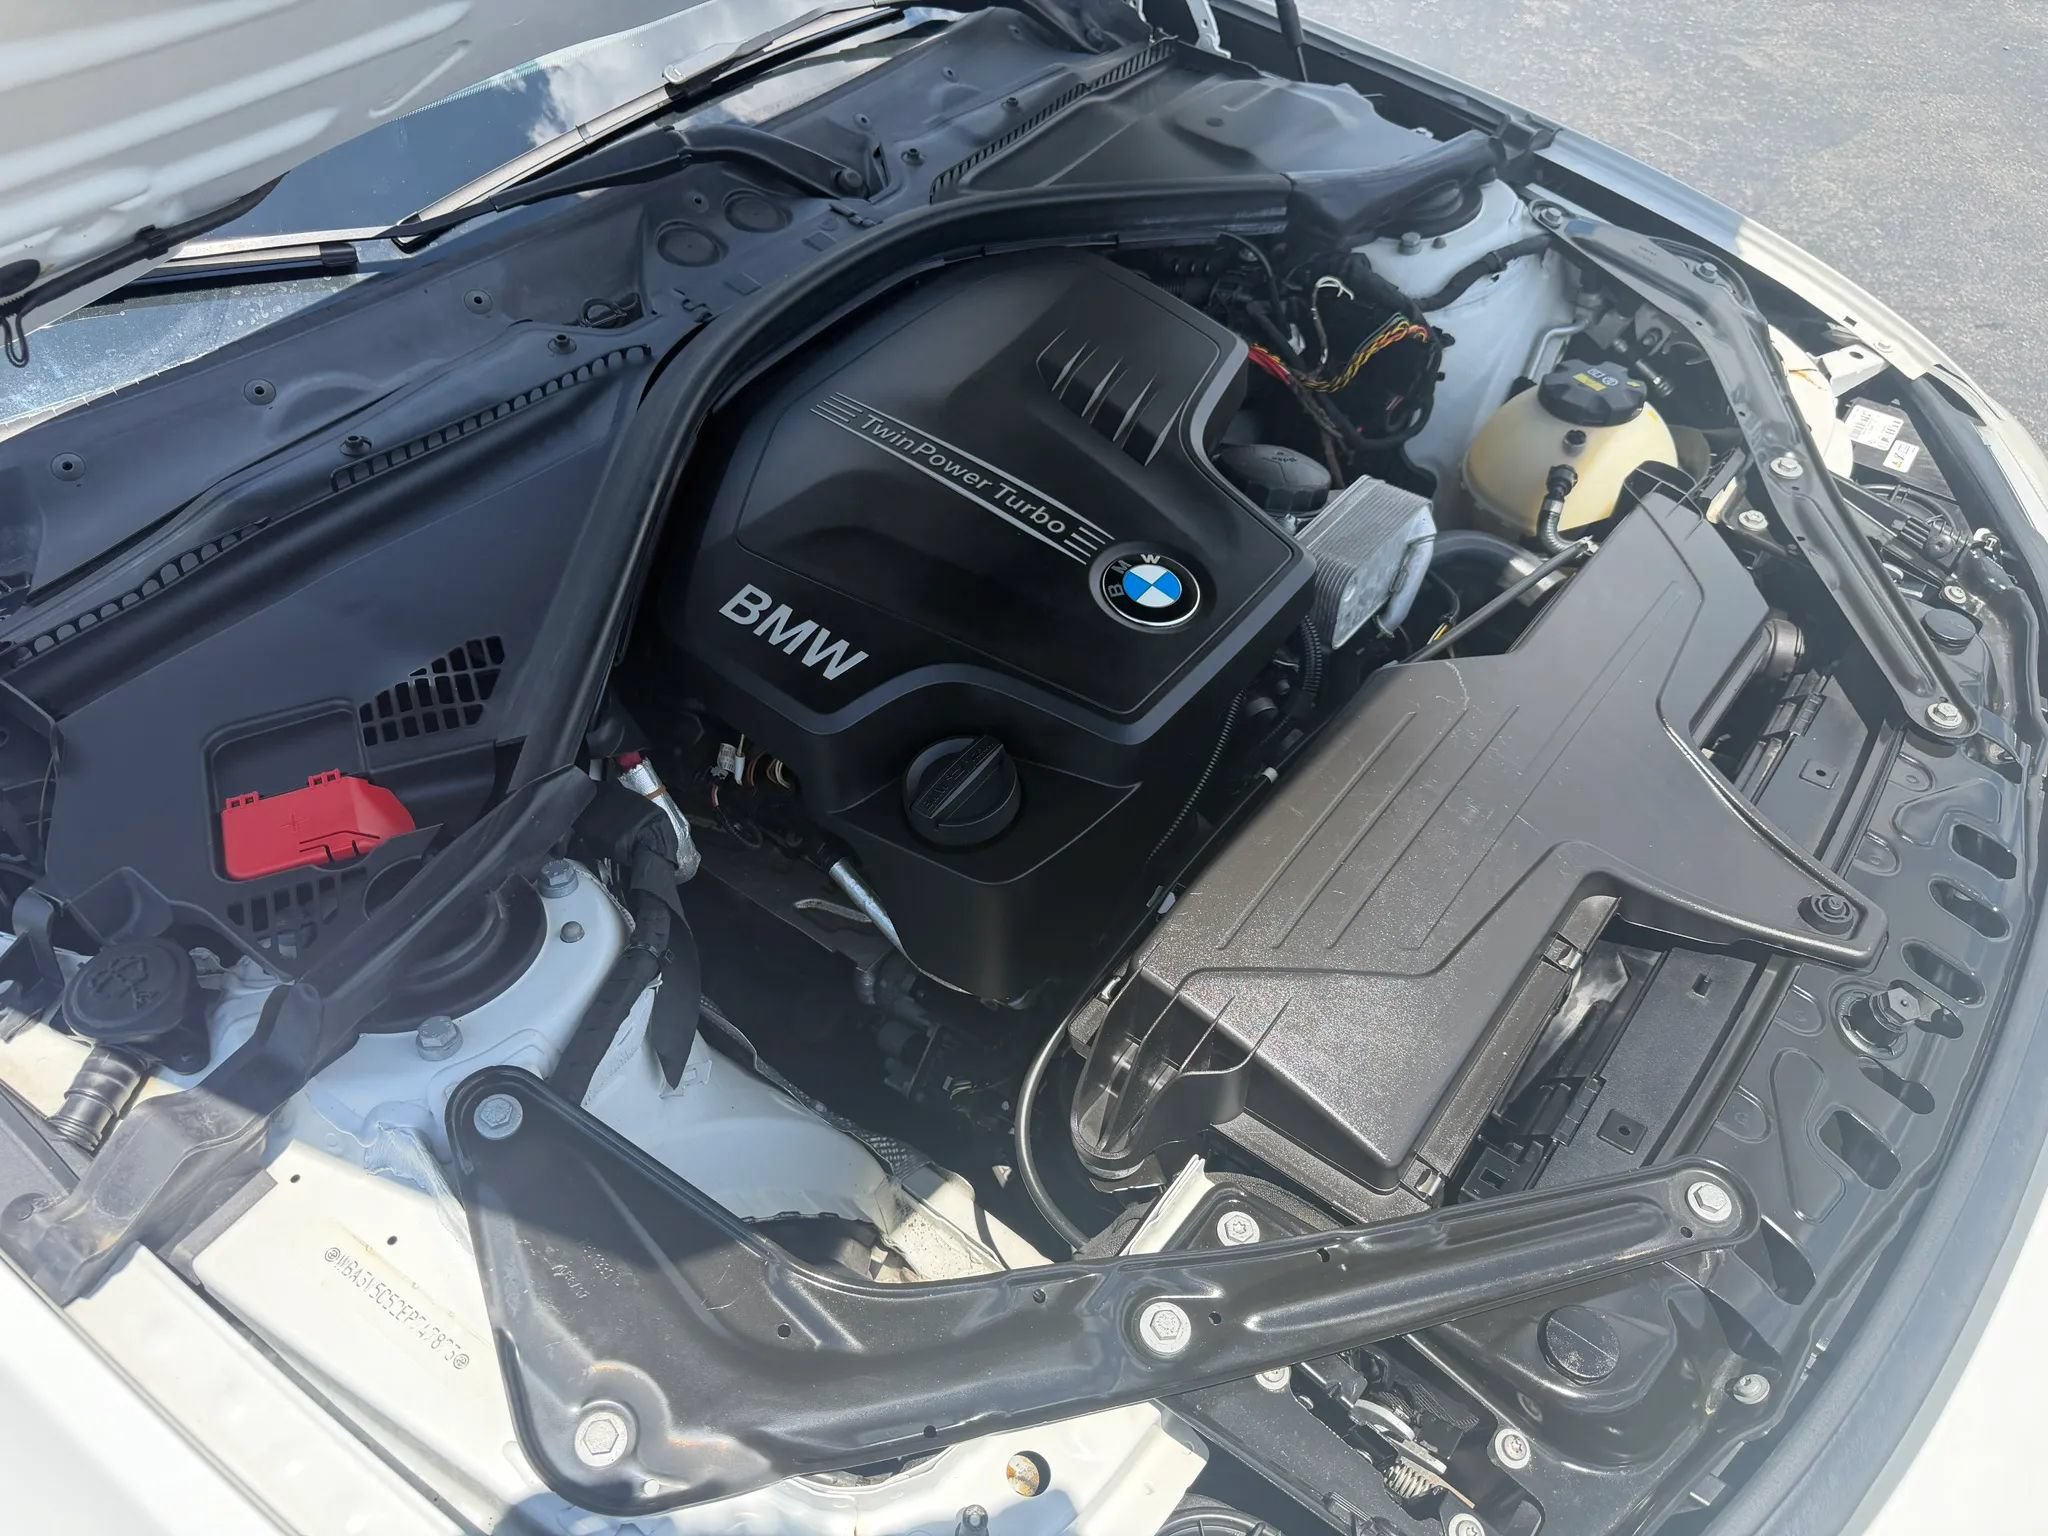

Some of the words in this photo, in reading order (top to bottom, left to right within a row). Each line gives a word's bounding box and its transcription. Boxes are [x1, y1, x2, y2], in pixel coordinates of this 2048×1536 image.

[861, 413, 992, 491] TwinPower
[993, 482, 1066, 535] Turbo
[1109, 553, 1161, 598] BMW
[719, 583, 870, 681] BMW
